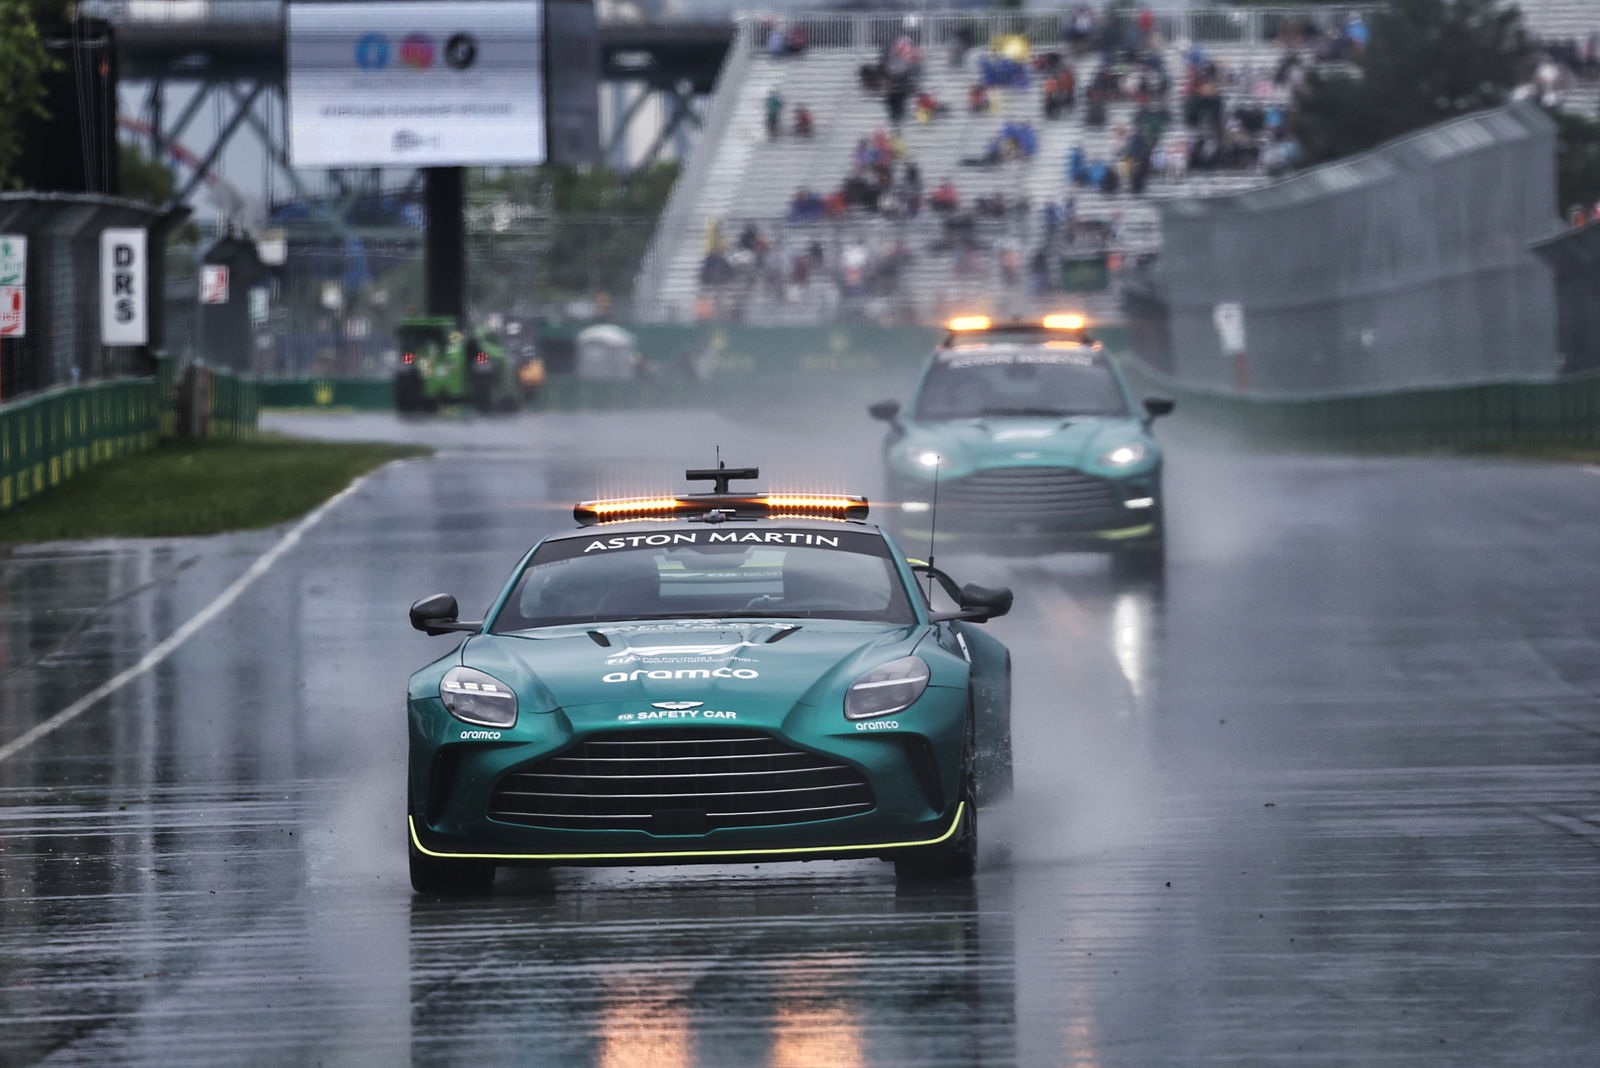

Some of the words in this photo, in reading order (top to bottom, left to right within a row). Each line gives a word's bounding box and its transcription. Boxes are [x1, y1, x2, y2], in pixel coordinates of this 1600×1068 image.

[112, 243, 135, 324] DRS
[583, 532, 697, 552] ASTON
[708, 532, 839, 547] MARTIN
[602, 667, 760, 683] aramco
[637, 710, 700, 720] SAFETY
[703, 710, 737, 720] CAR
[855, 720, 899, 731] aramco
[460, 730, 502, 739] aramco
